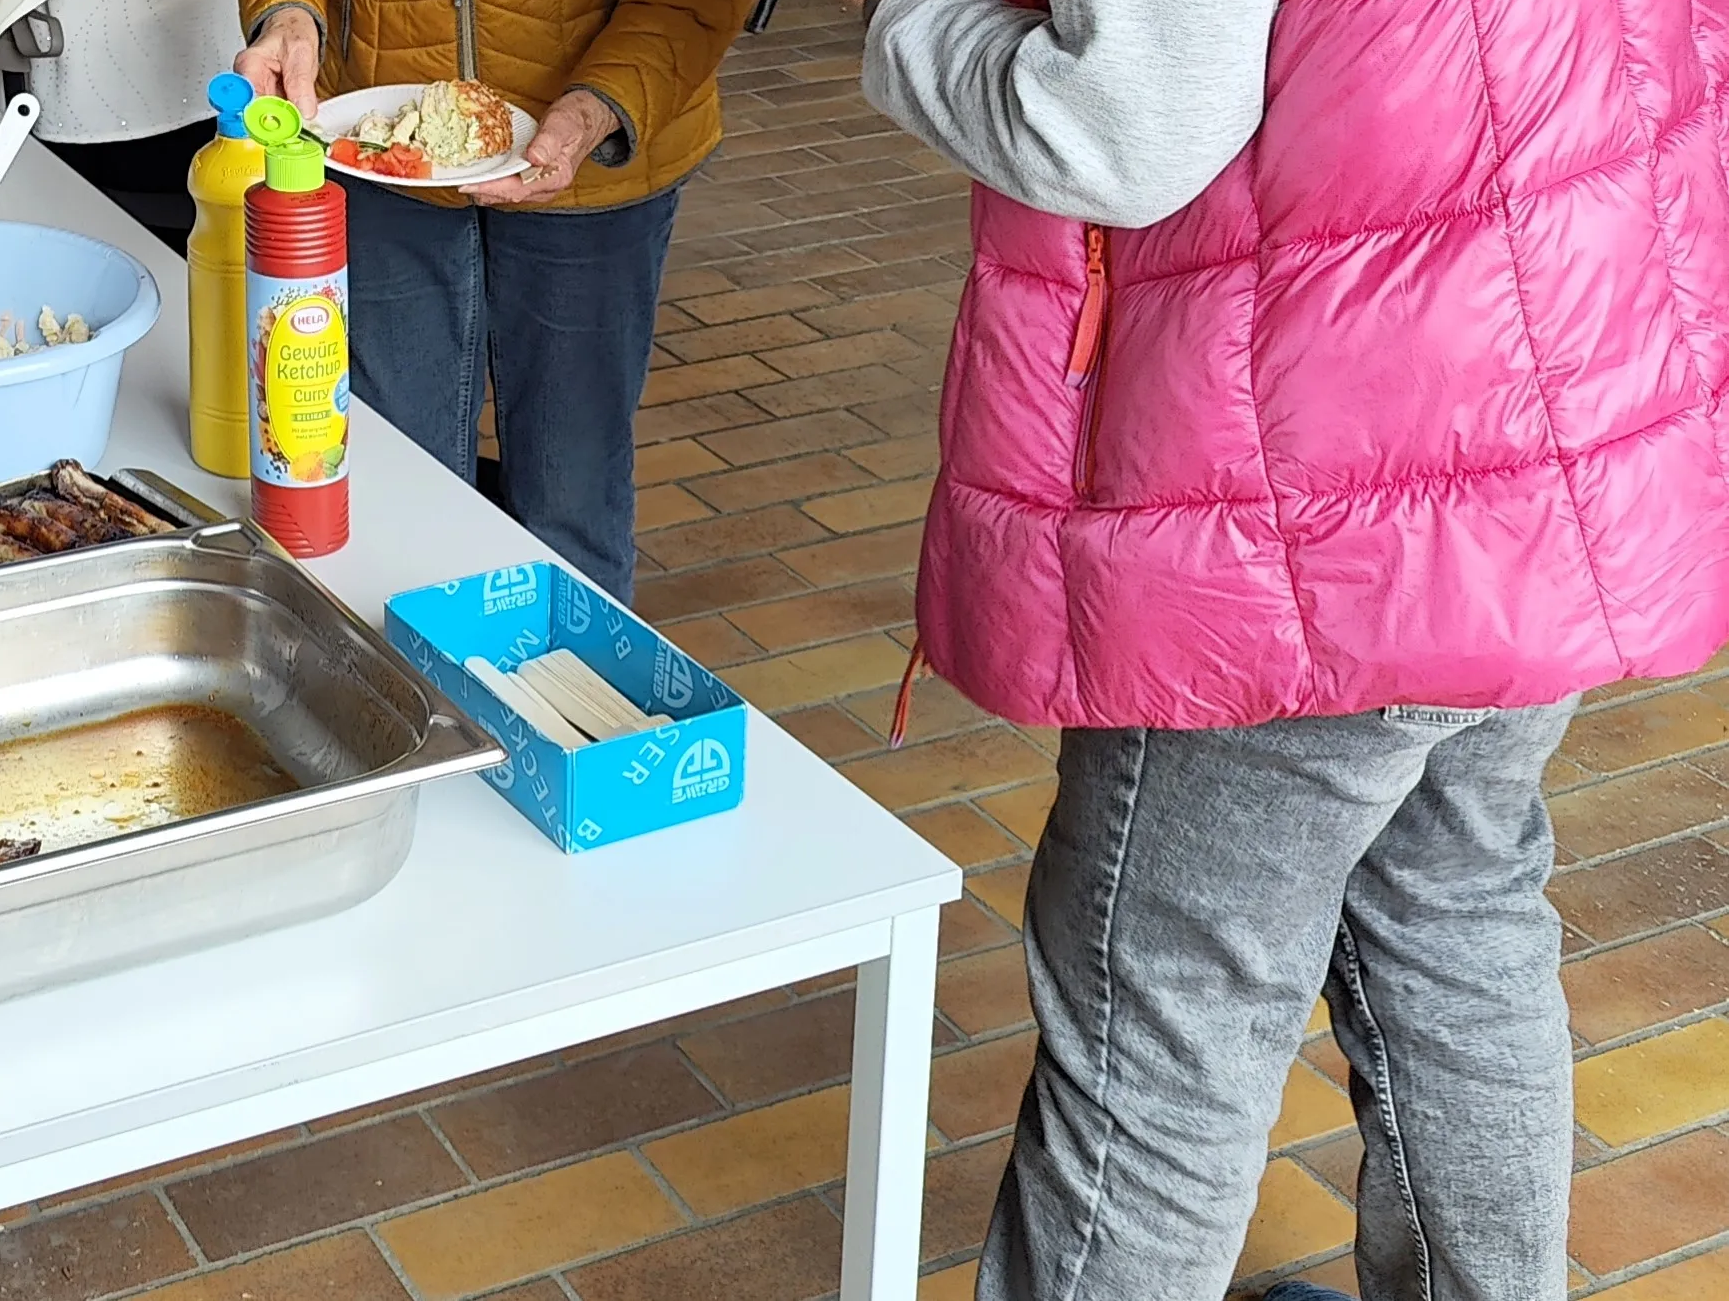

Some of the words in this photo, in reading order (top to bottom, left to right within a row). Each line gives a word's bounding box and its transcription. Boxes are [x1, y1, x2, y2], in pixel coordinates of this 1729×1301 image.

[297, 314, 324, 326] HELA
[279, 341, 339, 361] Gewürz
[277, 359, 341, 380] Ketchup
[293, 387, 330, 403] Curry
[622, 724, 681, 786] SER
